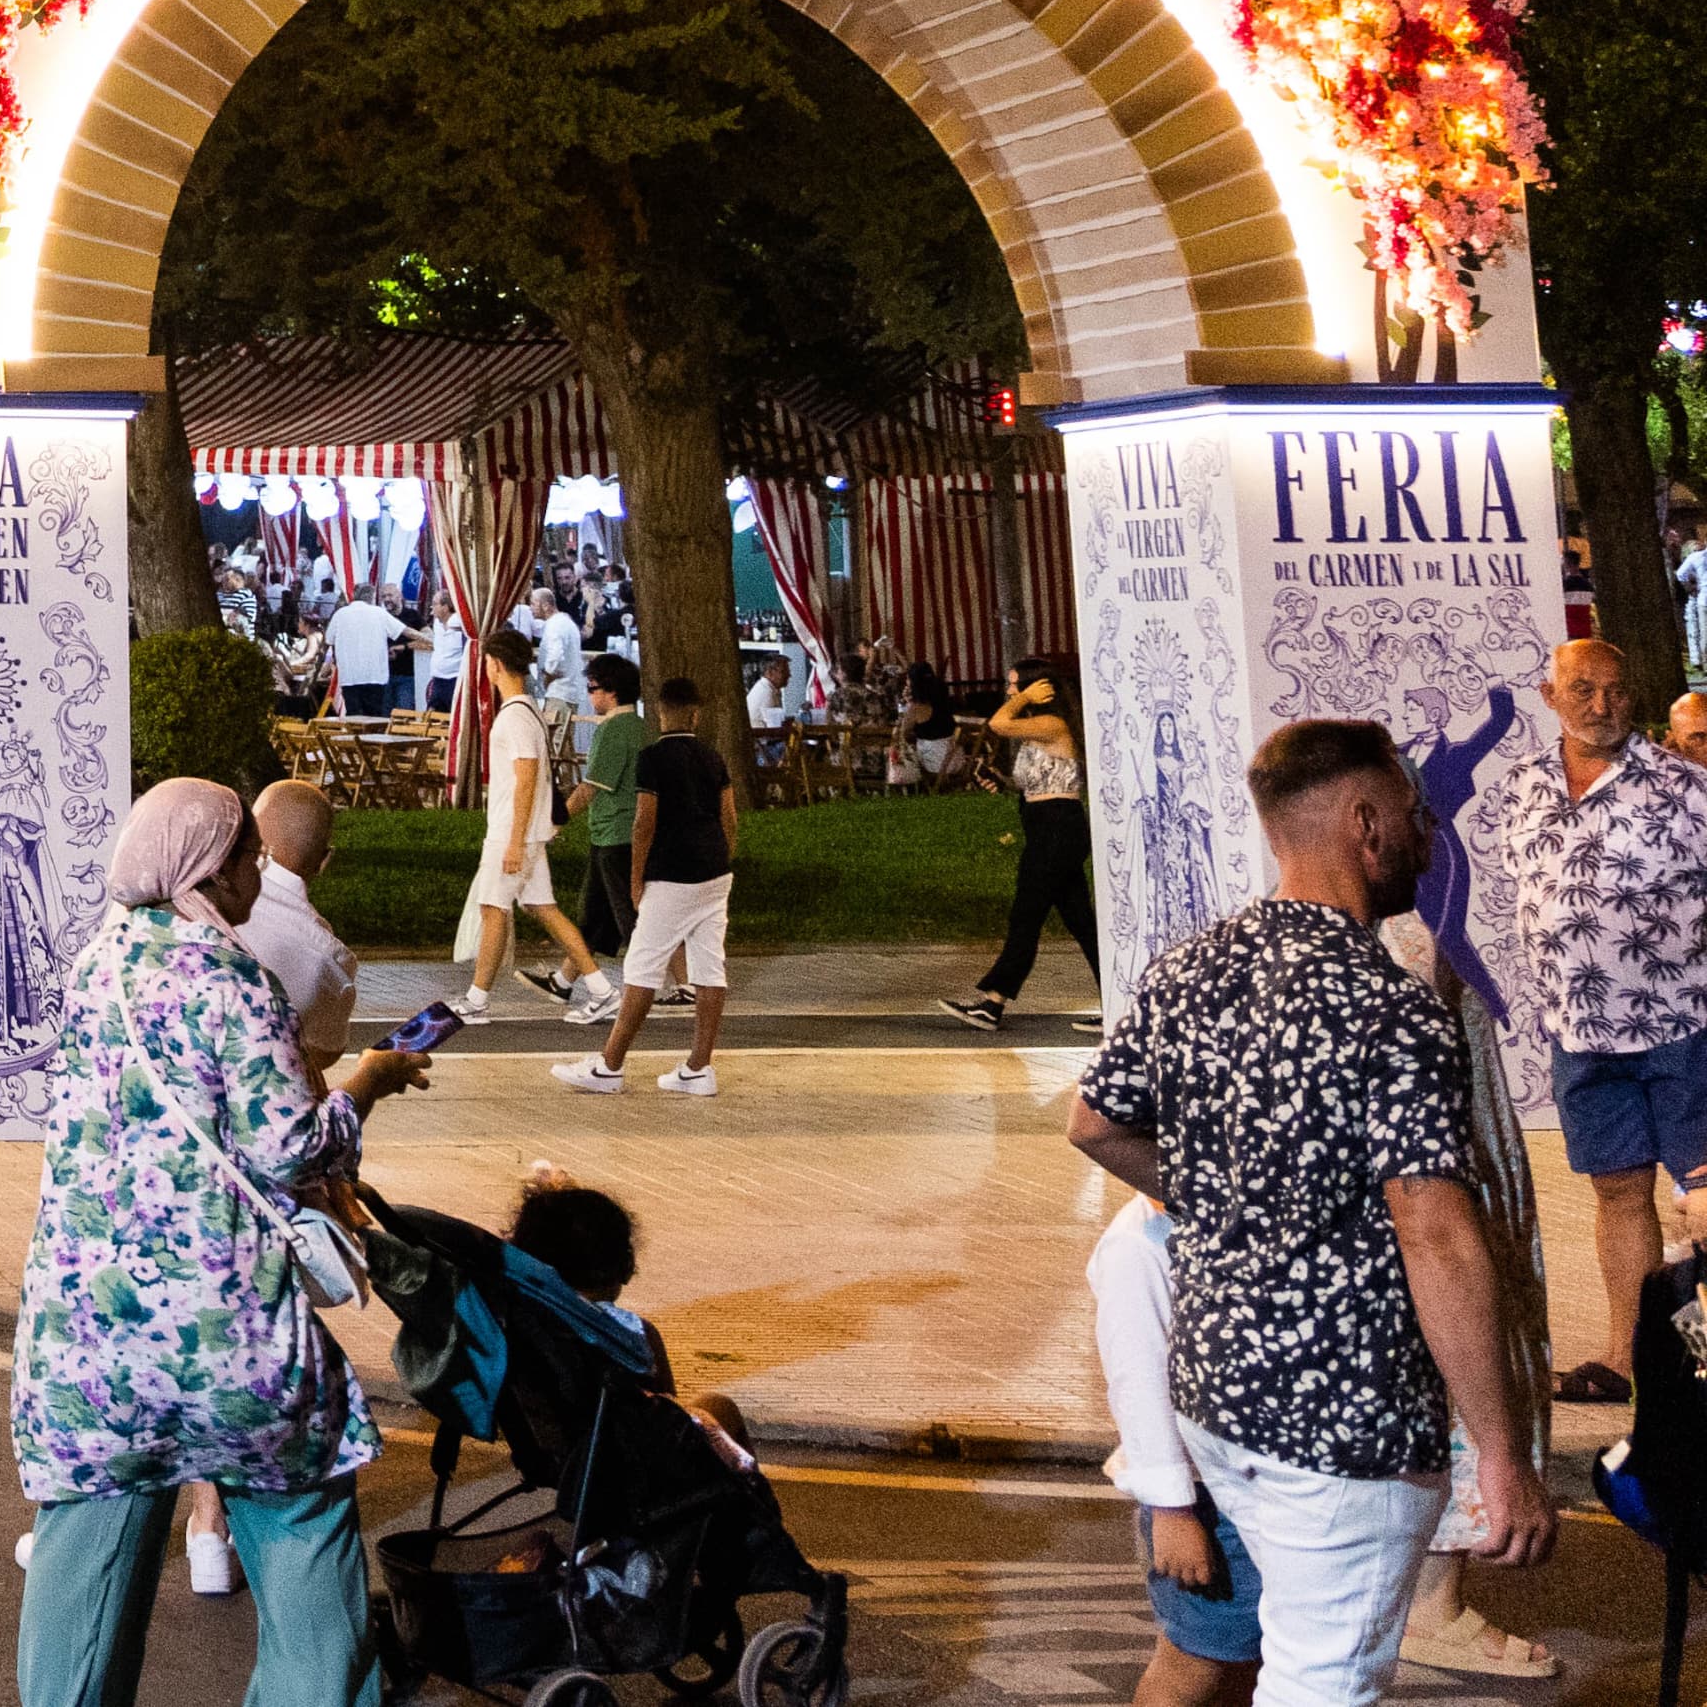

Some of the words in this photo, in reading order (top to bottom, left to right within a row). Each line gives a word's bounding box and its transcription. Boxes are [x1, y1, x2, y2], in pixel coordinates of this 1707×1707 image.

[1116, 439, 1182, 511] VIVA
[1267, 430, 1528, 543] FERIA
[1125, 518, 1186, 558] VIRGEN
[1132, 567, 1189, 602] CARMEN
[1274, 561, 1300, 581] DEL
[1308, 554, 1404, 587] CARMEN
[1413, 561, 1421, 580] Y
[1426, 561, 1443, 581] DE
[1452, 554, 1481, 587] LA
[1487, 553, 1531, 587] SAL
